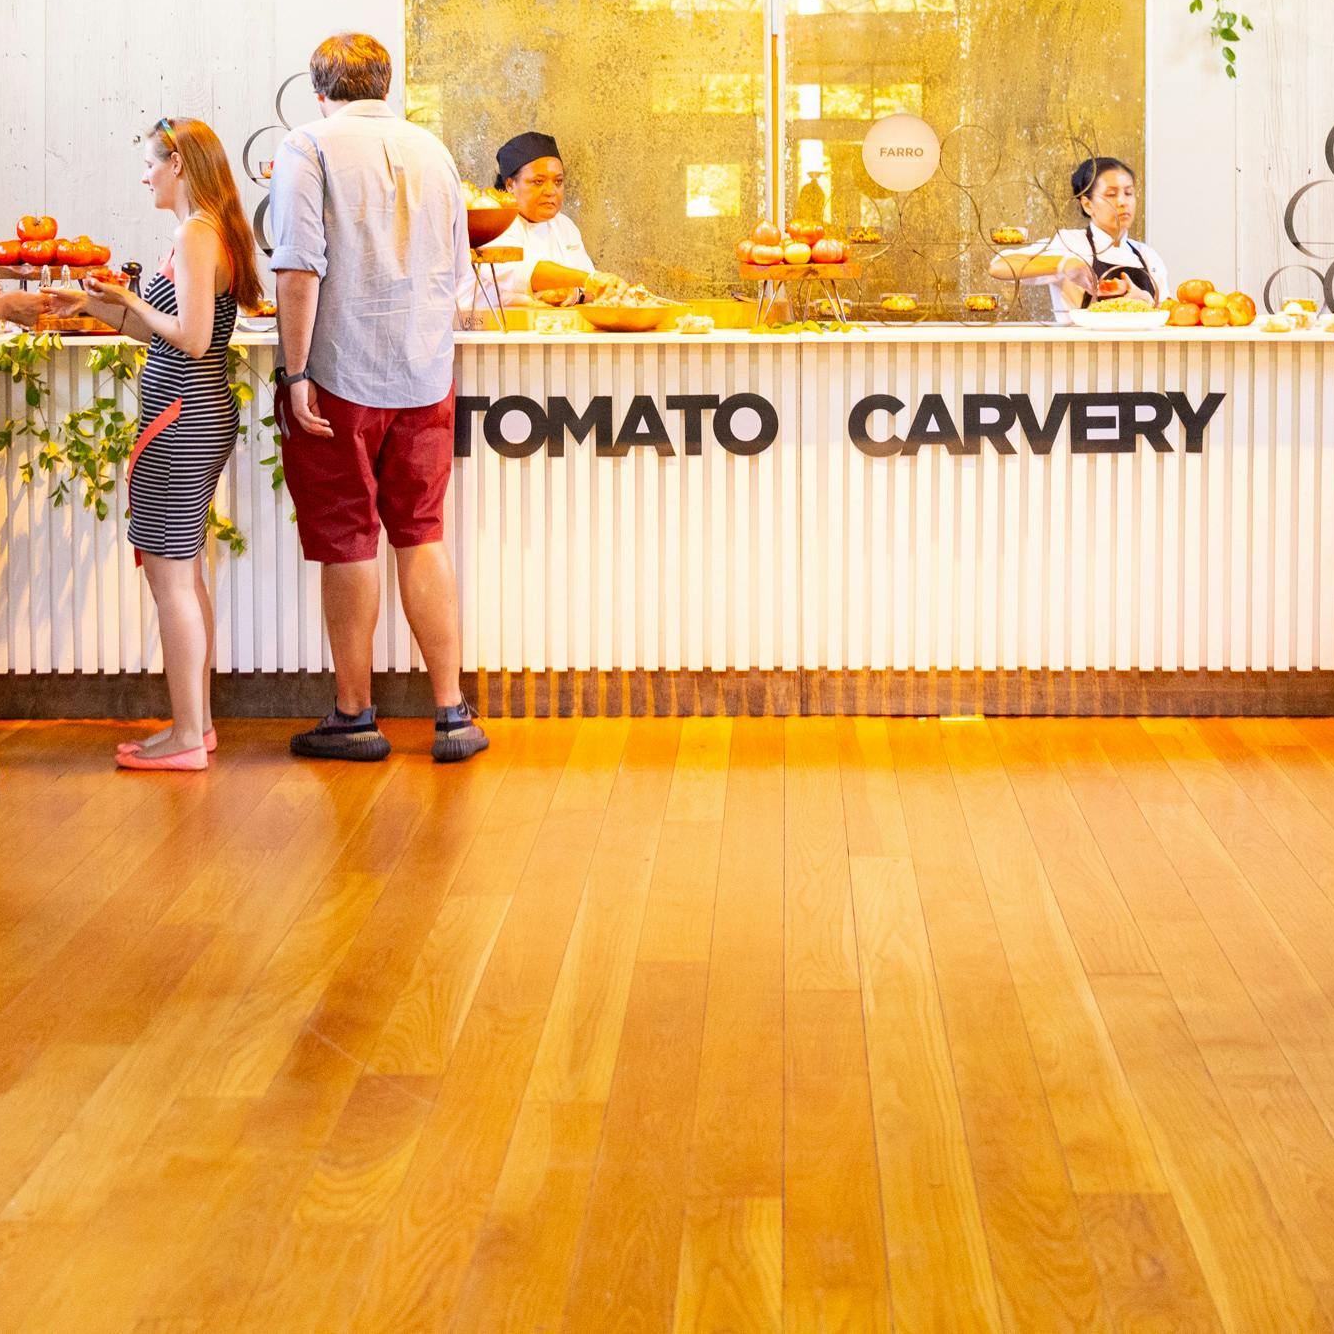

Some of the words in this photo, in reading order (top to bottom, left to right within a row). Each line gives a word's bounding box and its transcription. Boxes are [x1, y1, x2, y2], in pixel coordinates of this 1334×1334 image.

[879, 147, 924, 157] FARRO
[454, 392, 779, 457] TOMATO
[847, 391, 1226, 456] CARVERY
